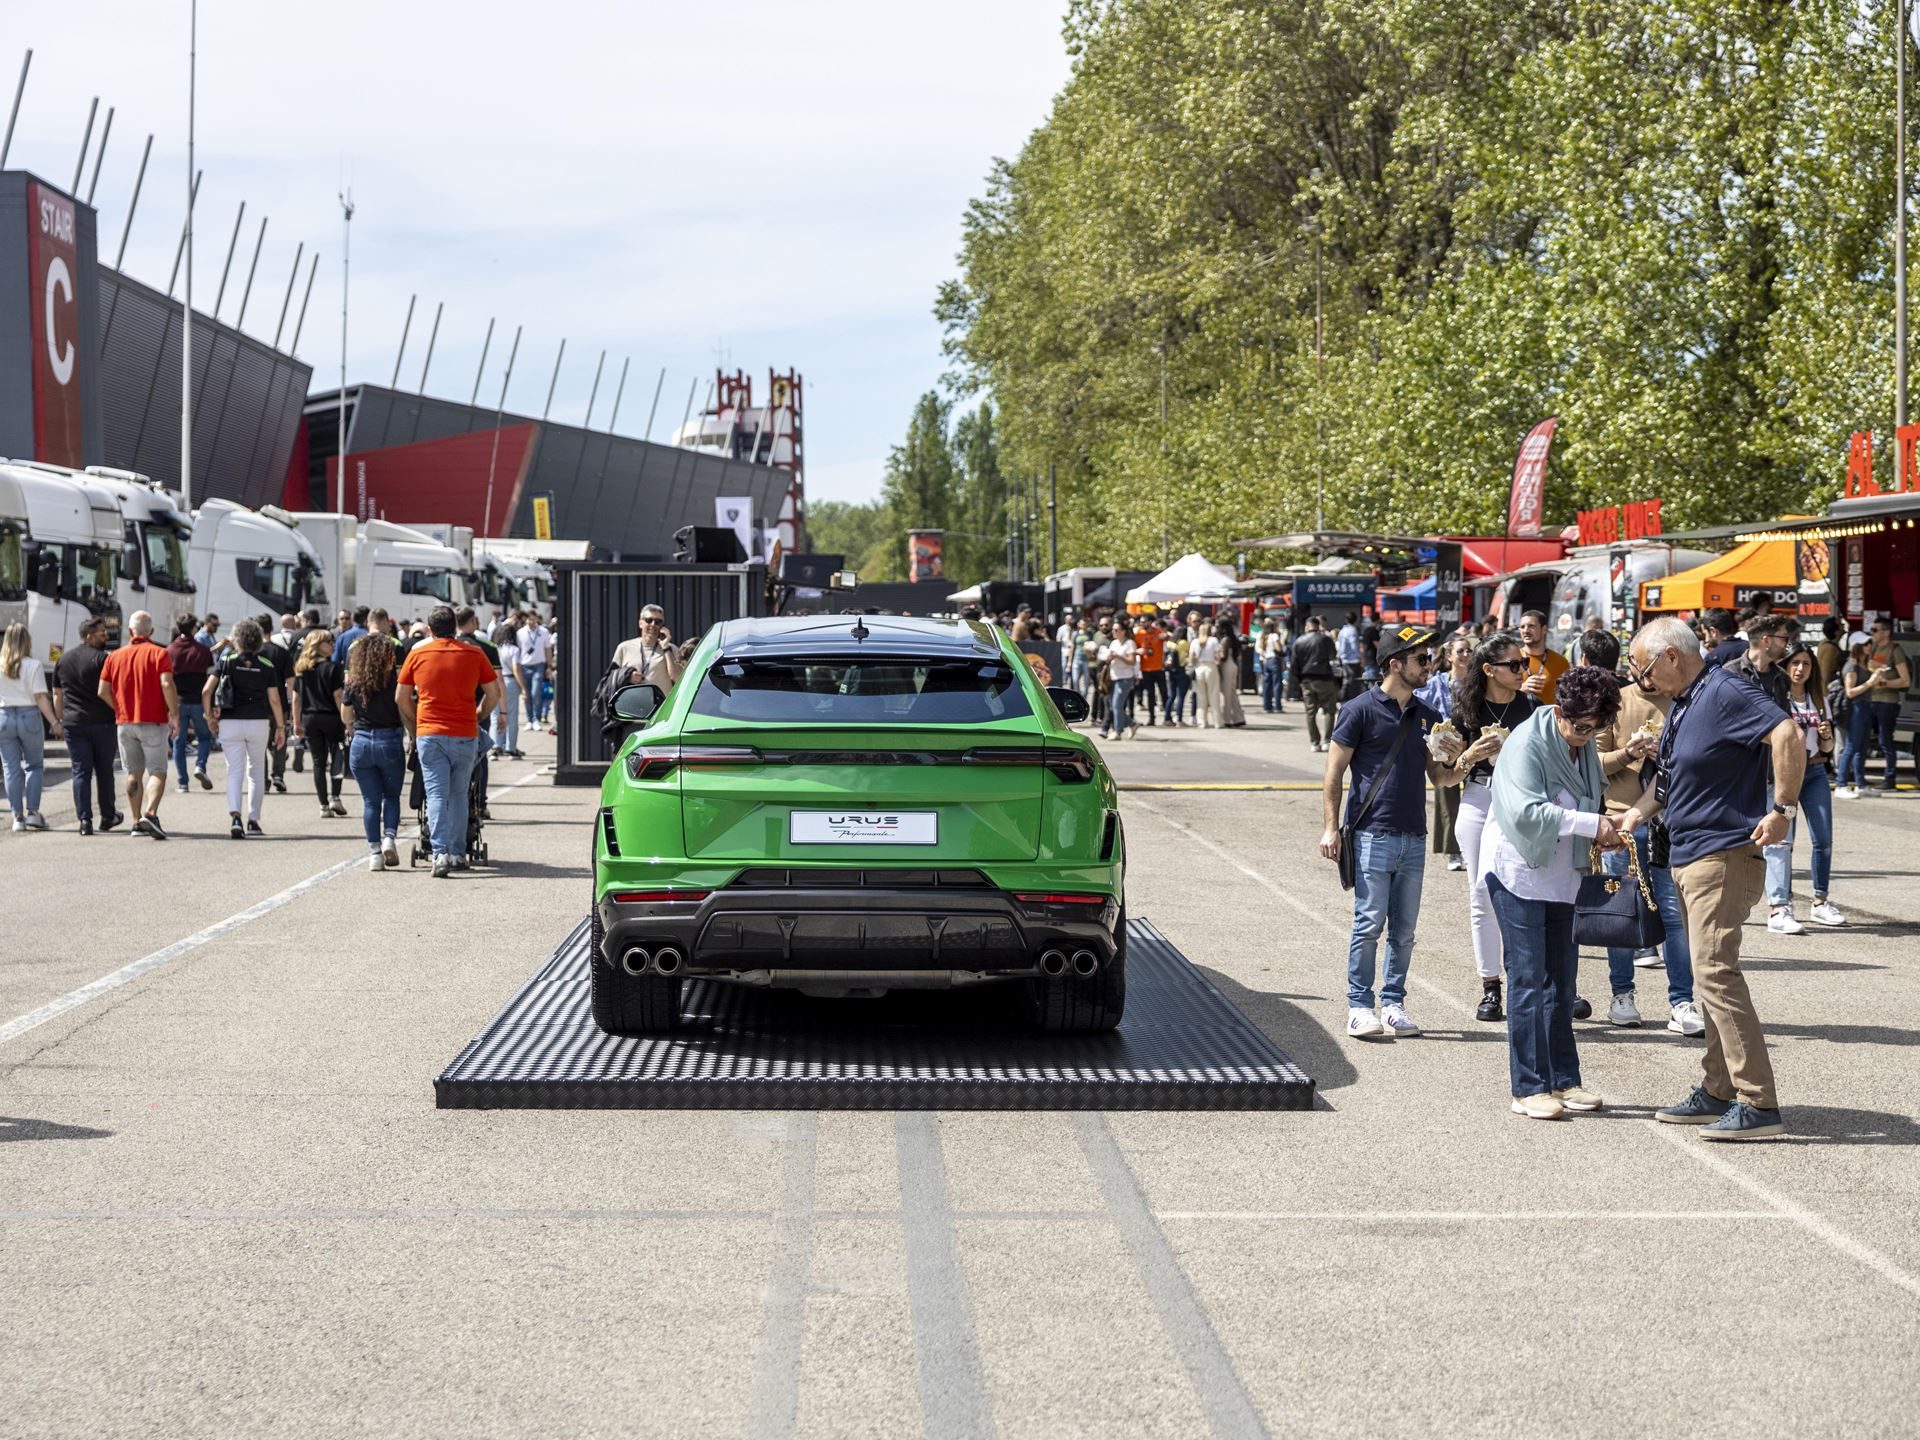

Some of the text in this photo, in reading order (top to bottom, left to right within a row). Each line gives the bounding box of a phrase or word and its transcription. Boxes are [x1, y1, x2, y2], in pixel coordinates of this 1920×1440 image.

[40, 201, 73, 244] STAIR
[46, 256, 75, 386] C
[1845, 431, 1879, 498] AL
[1307, 583, 1365, 593] ASPASSO
[1774, 590, 1798, 603] DO
[828, 815, 899, 825] URUS
[832, 829, 896, 839] Performante
